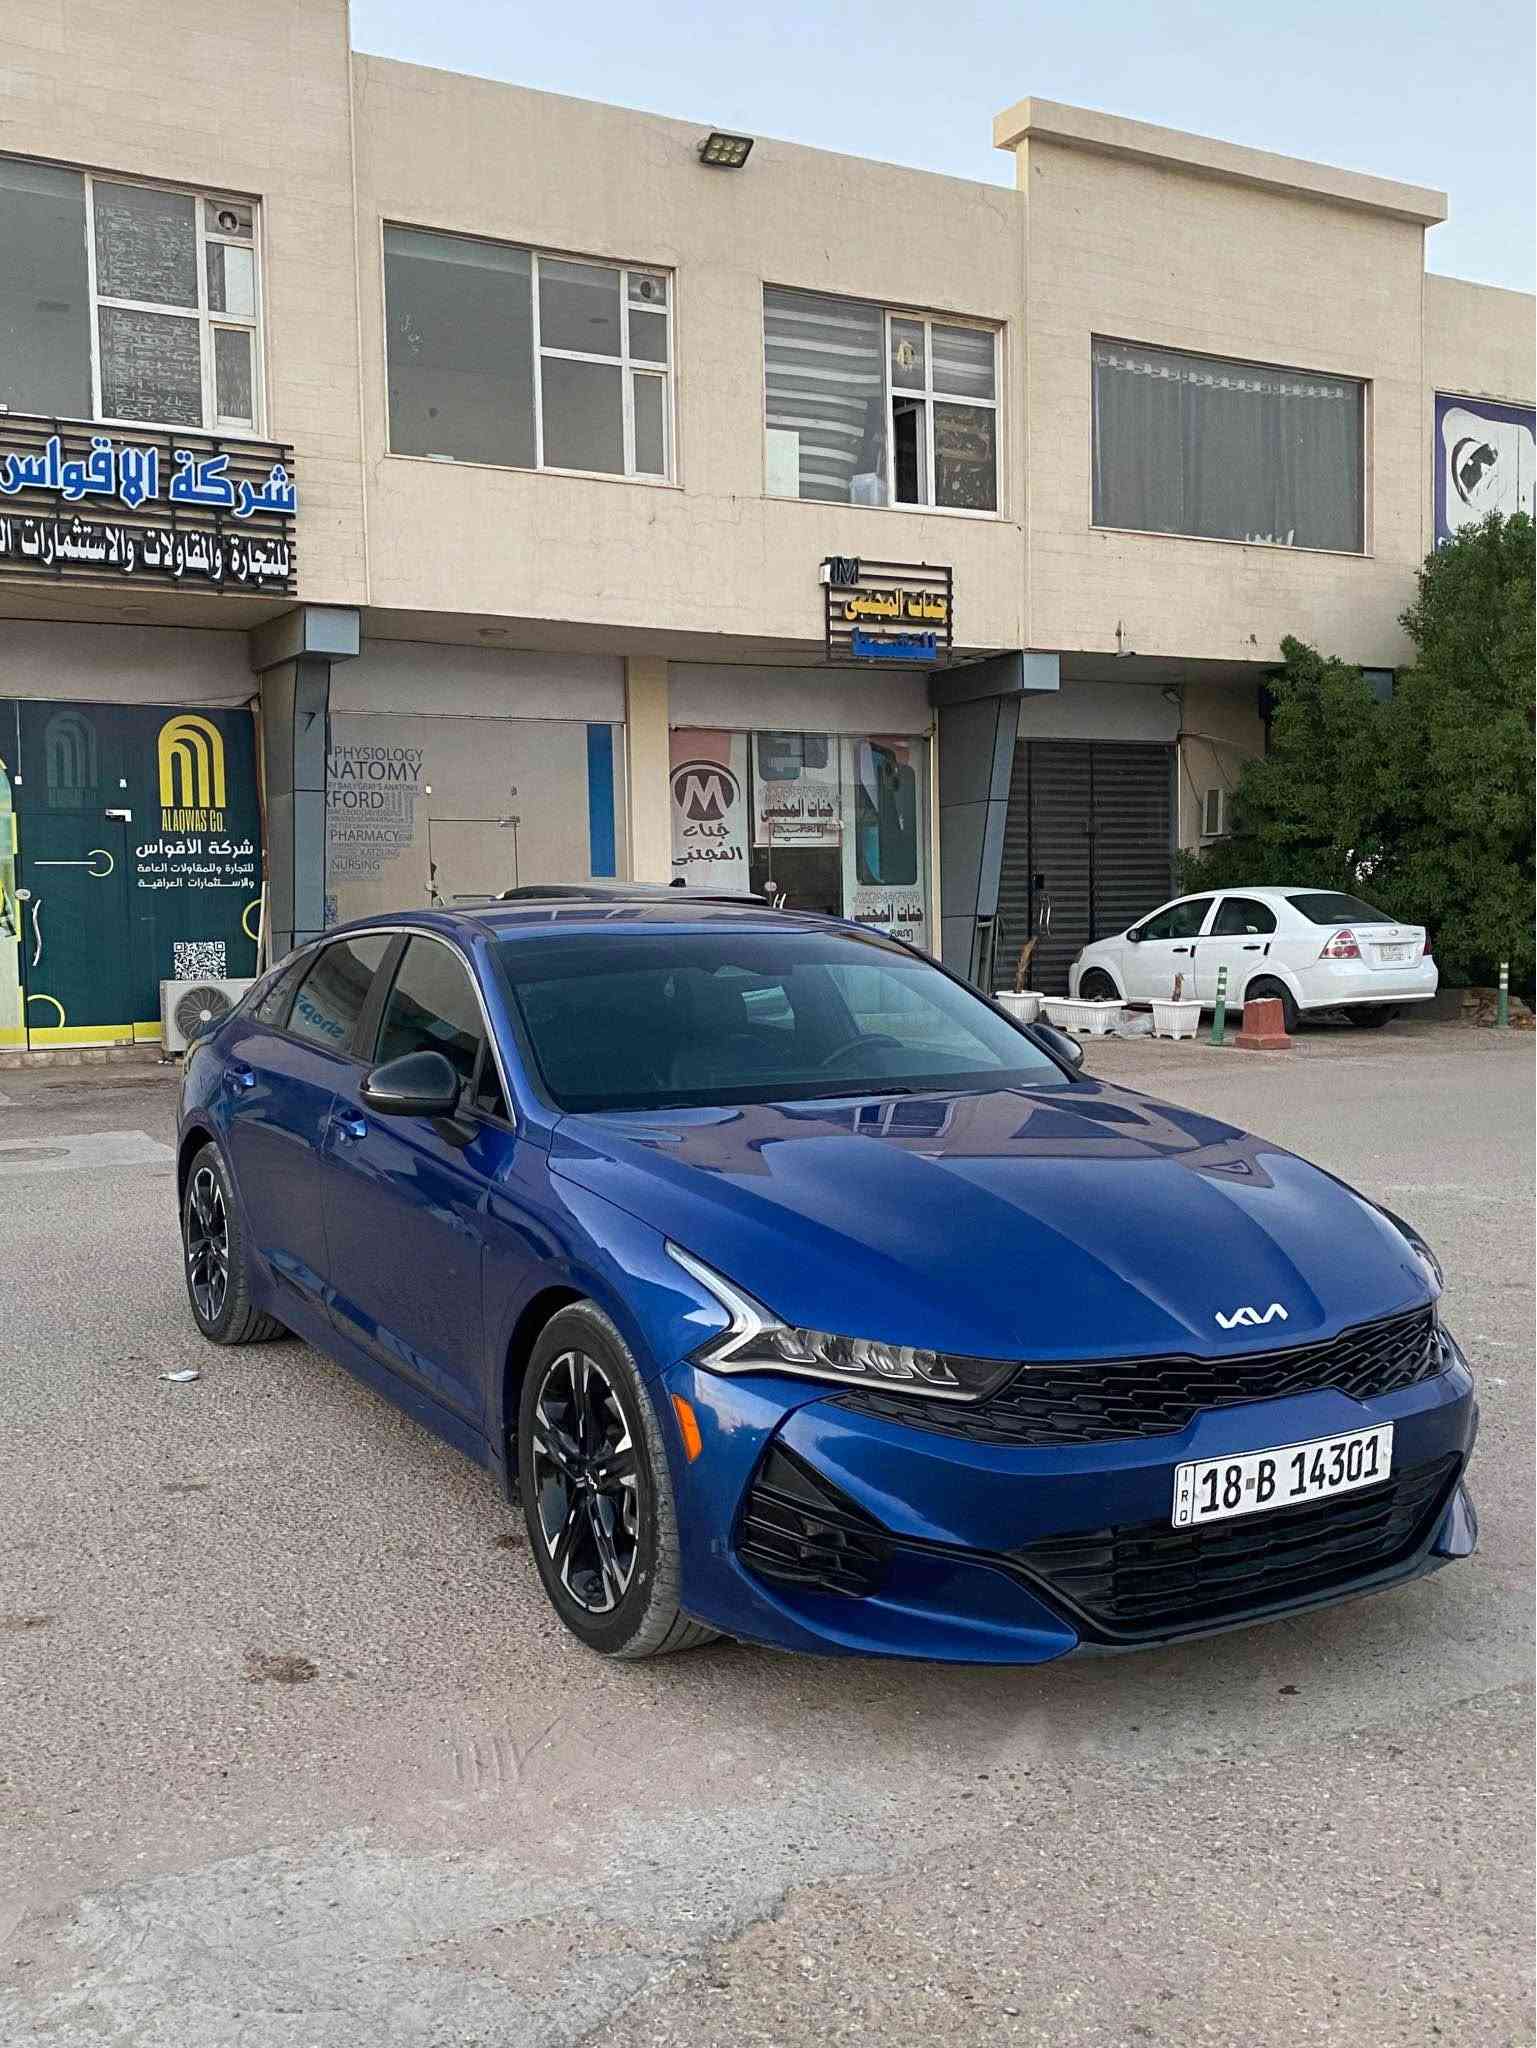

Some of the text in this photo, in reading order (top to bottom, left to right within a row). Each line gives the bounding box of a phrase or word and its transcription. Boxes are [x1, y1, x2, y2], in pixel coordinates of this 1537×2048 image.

[170, 450, 297, 518] شركة
[21, 518, 135, 572] والاستثمارات
[143, 530, 223, 577] والمقاولات
[231, 536, 289, 584] للتجارة
[335, 746, 423, 762] PHYSIOLOGY
[162, 808, 207, 834] ALAQWAS
[331, 830, 399, 841] PHARMACY
[208, 839, 254, 859] شركة
[137, 863, 168, 873] العامة
[225, 863, 254, 874] للتجارة
[332, 859, 380, 872] NURSING
[1200, 1434, 1379, 1514] 18 B 14301
